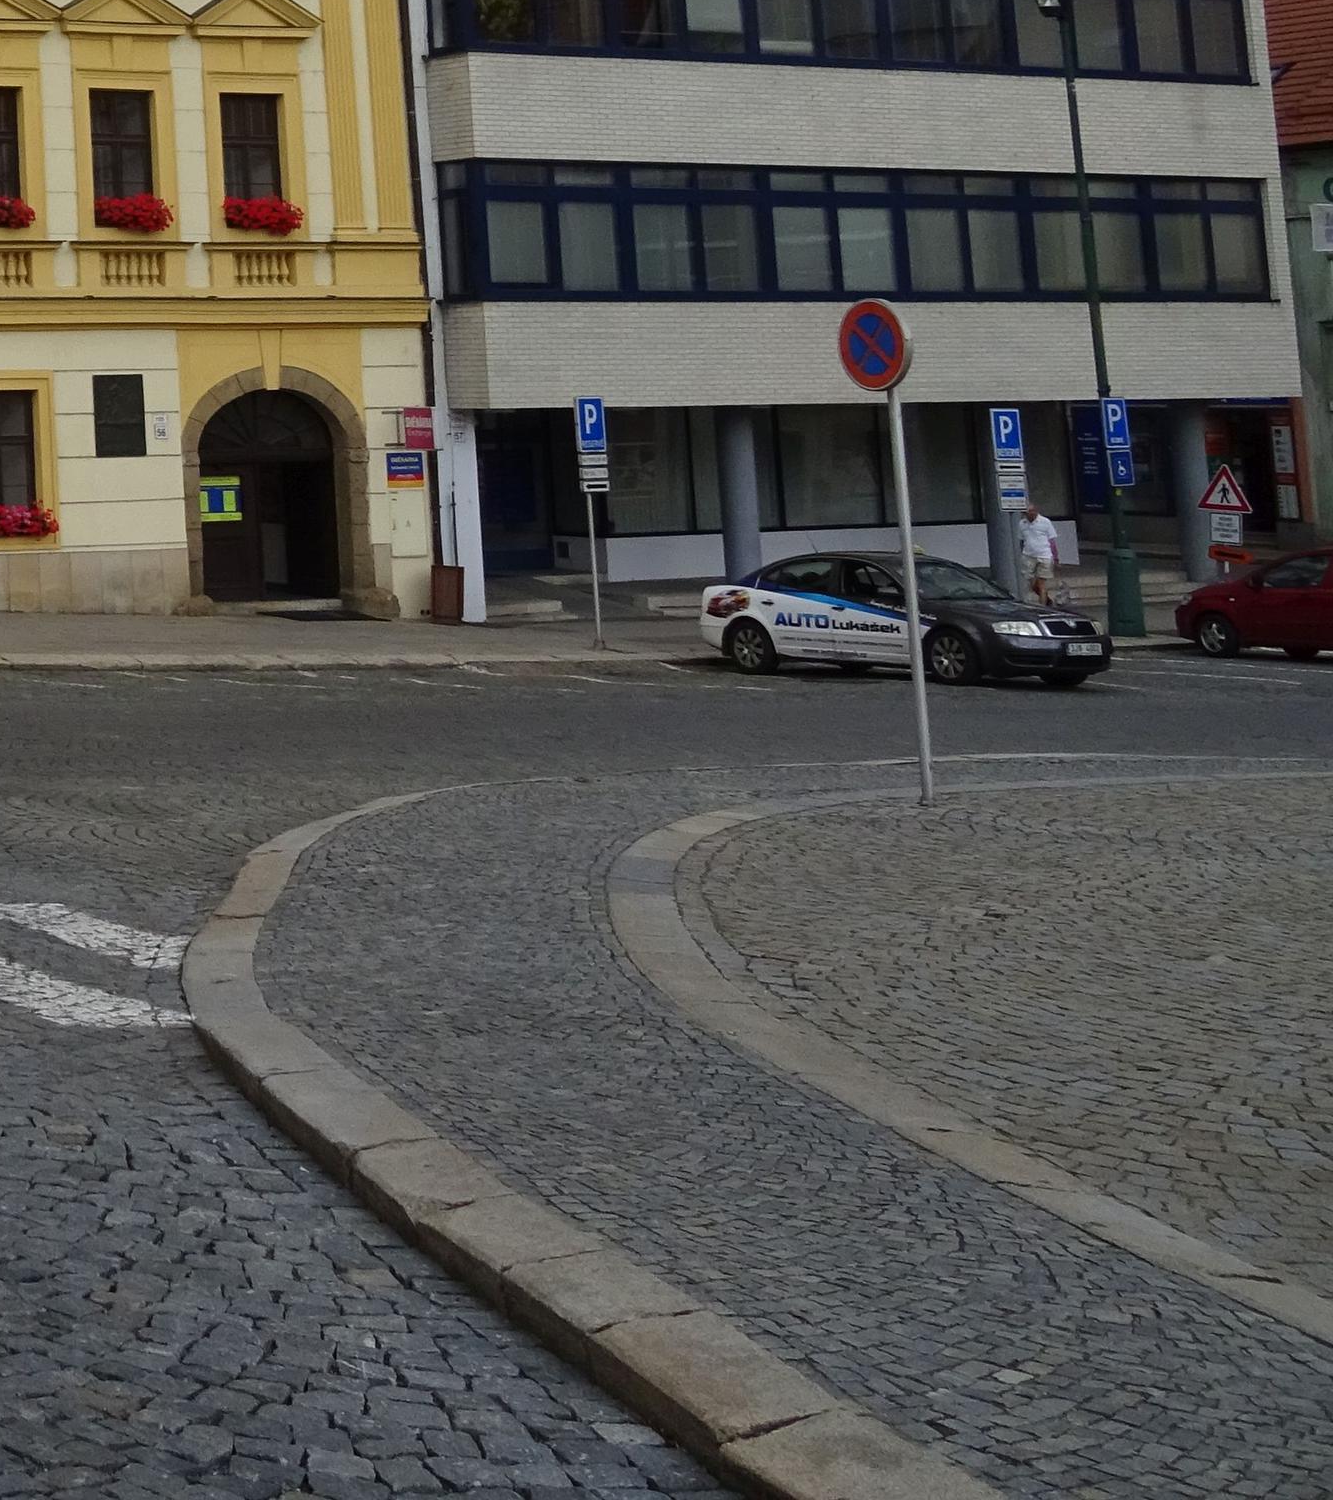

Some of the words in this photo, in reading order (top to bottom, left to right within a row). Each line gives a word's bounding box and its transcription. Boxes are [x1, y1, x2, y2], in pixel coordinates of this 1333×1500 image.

[584, 403, 597, 435] P
[999, 415, 1013, 444] P
[1106, 403, 1122, 432] P
[157, 428, 166, 437] 56
[774, 612, 830, 629] AUTO
[832, 619, 901, 634] Lukášek
